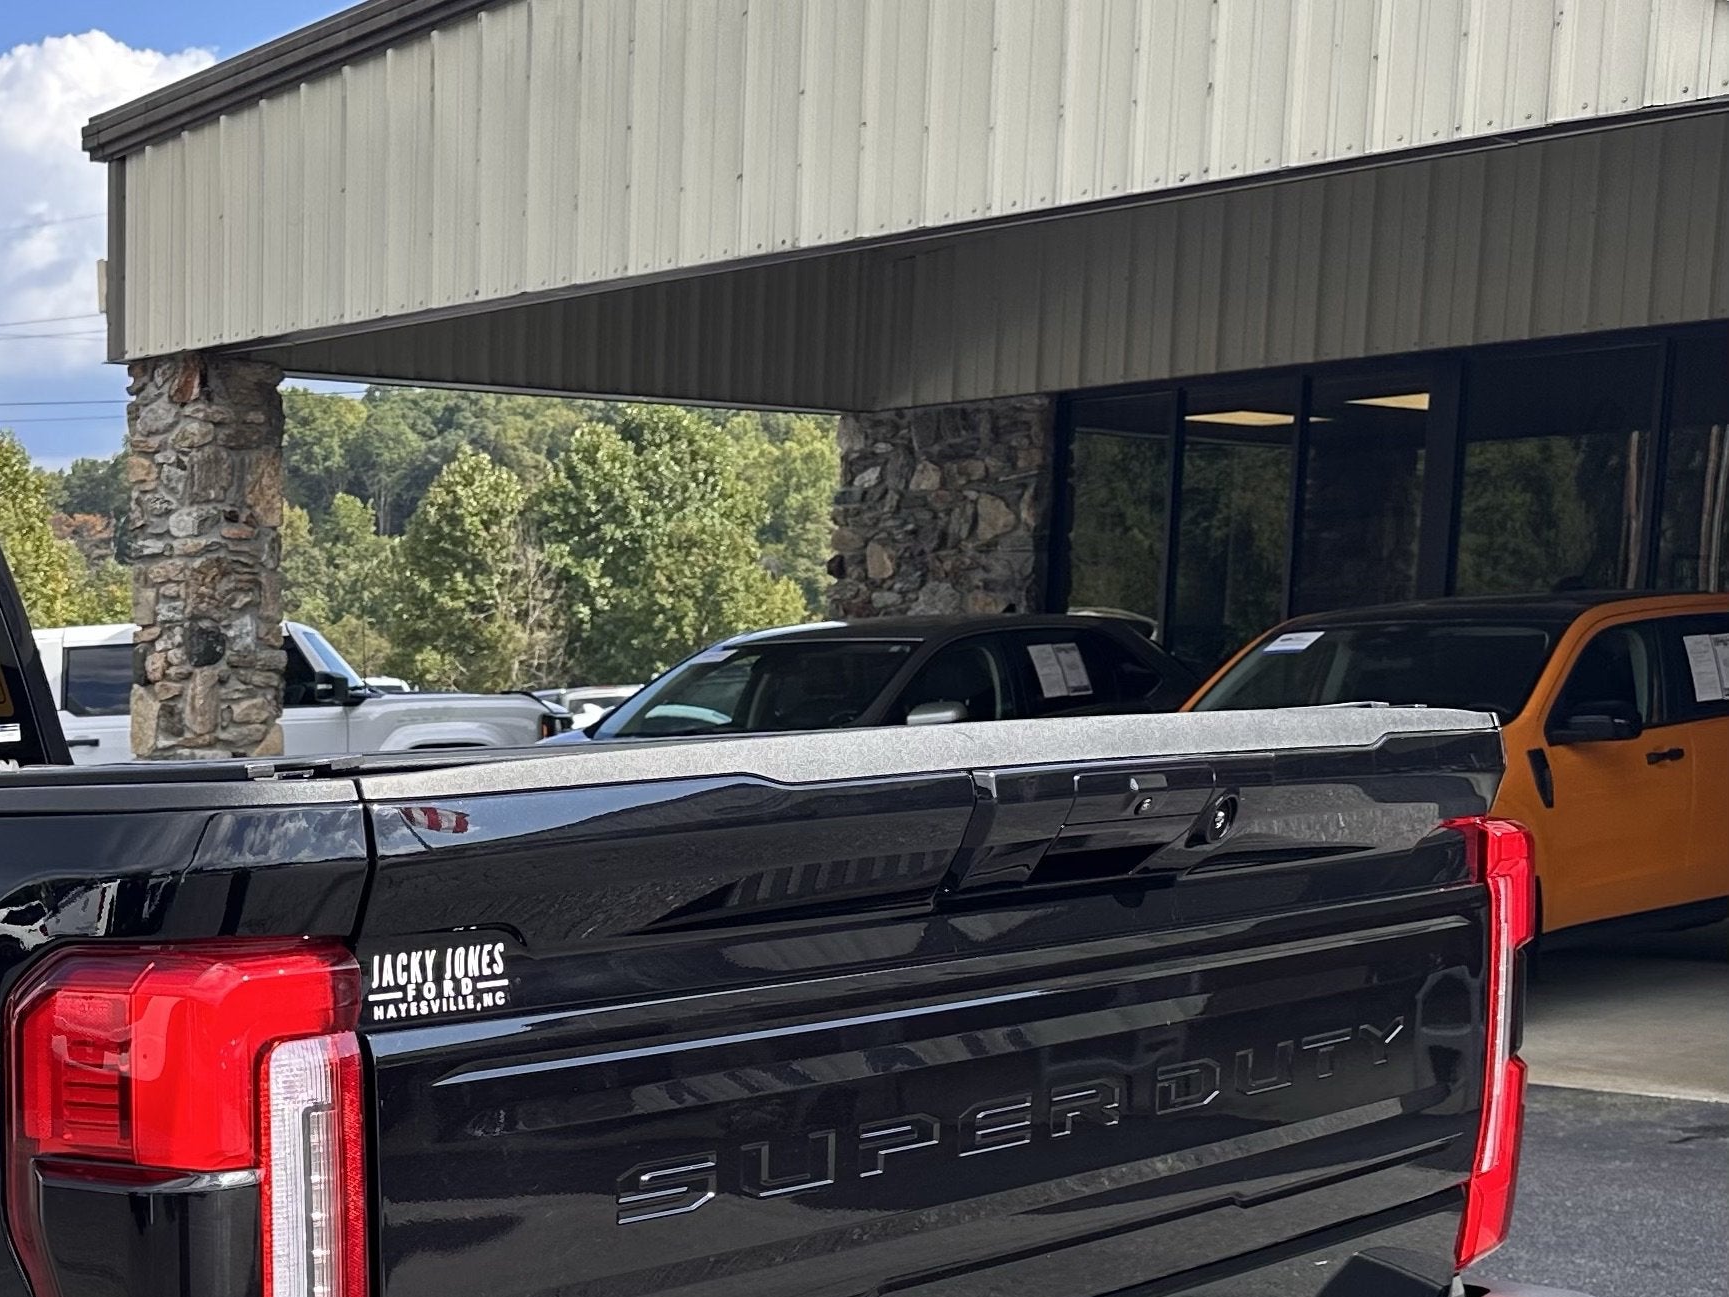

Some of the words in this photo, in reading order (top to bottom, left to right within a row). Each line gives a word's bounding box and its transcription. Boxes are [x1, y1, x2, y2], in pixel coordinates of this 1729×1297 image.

[372, 949, 436, 989] JACKY
[445, 942, 505, 980] JONES
[406, 977, 473, 1002] FORD
[616, 1078, 1121, 1225] SUPER
[1155, 1014, 1405, 1115] DUTY
